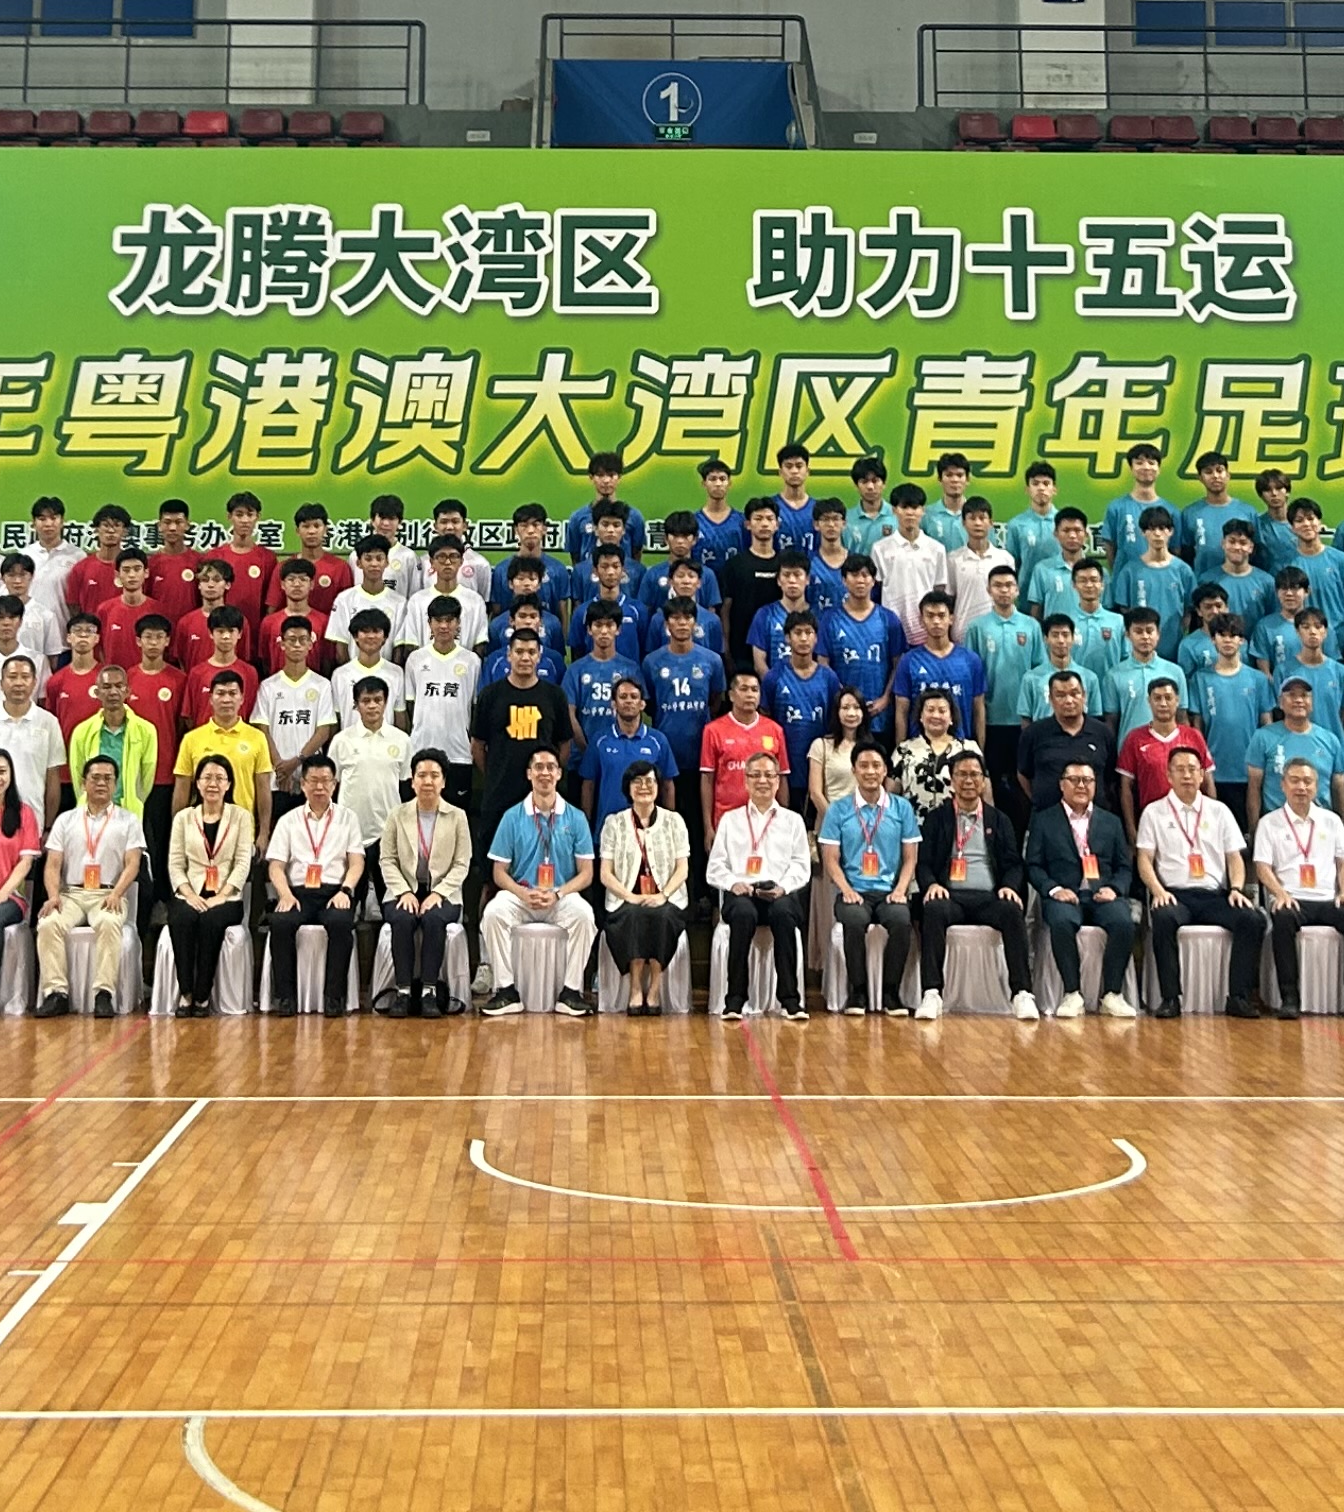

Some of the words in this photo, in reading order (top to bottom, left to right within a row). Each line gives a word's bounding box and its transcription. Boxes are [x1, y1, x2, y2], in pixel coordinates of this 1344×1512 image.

[115, 204, 657, 316] 龙腾大湾区
[747, 205, 1299, 322] 助力十五运
[424, 682, 460, 698] 东莞
[591, 682, 612, 701] 35
[278, 709, 311, 726] 东莞
